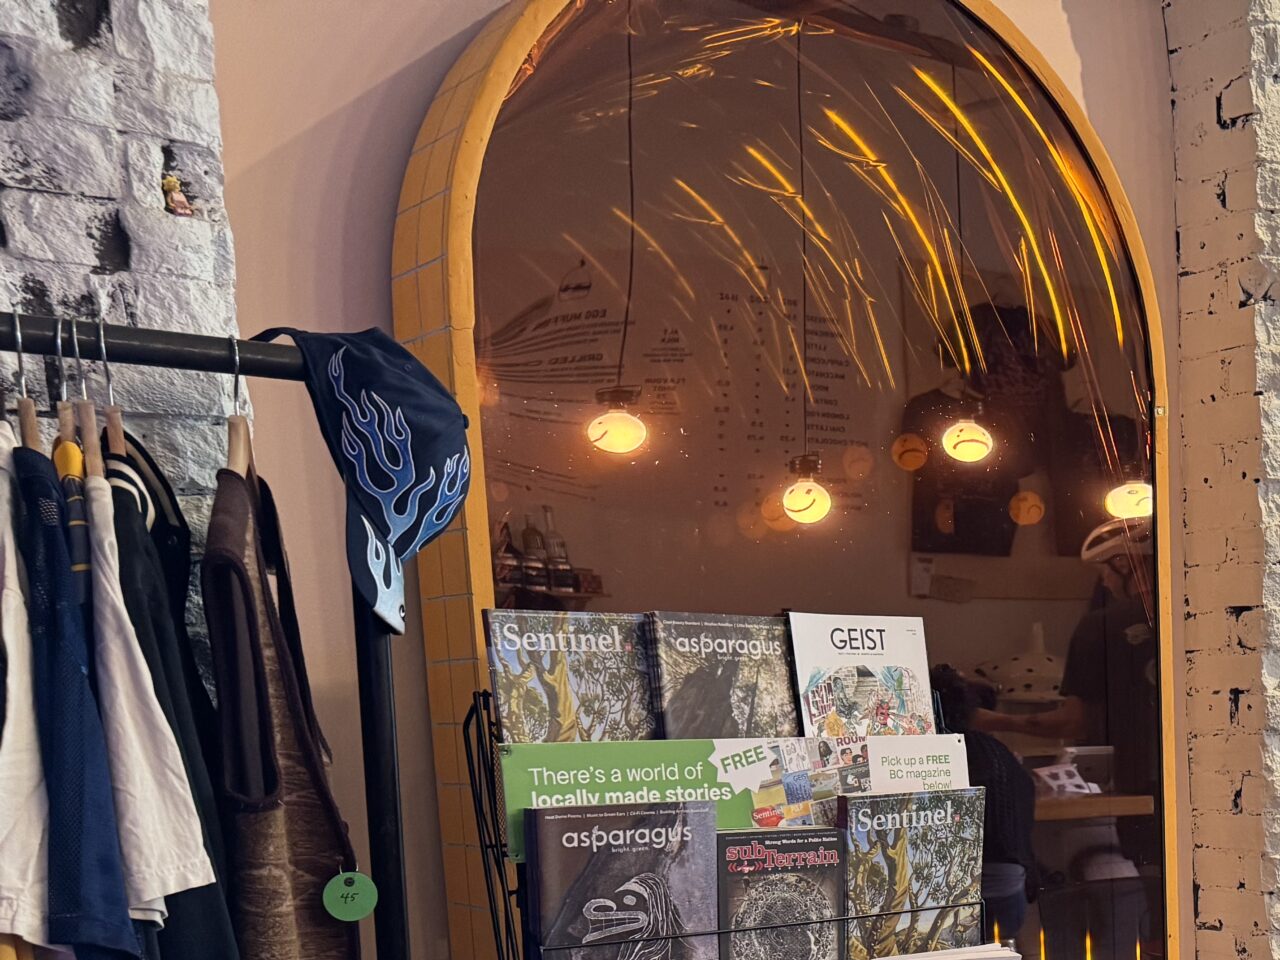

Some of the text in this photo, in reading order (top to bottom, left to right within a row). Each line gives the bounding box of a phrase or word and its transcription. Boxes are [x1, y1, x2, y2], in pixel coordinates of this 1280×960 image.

[503, 623, 623, 652] Sentinel
[675, 632, 782, 660] asparagus
[830, 628, 886, 651] GEIST
[720, 745, 767, 774] FREE
[881, 755, 950, 768] Pick up a FREE
[528, 762, 704, 786] There's a world of
[889, 768, 951, 780] BC magazine
[531, 783, 732, 808] locally made stories
[857, 801, 954, 832] Sentinel
[562, 825, 692, 852] asparagus
[340, 892, 359, 904] 45
